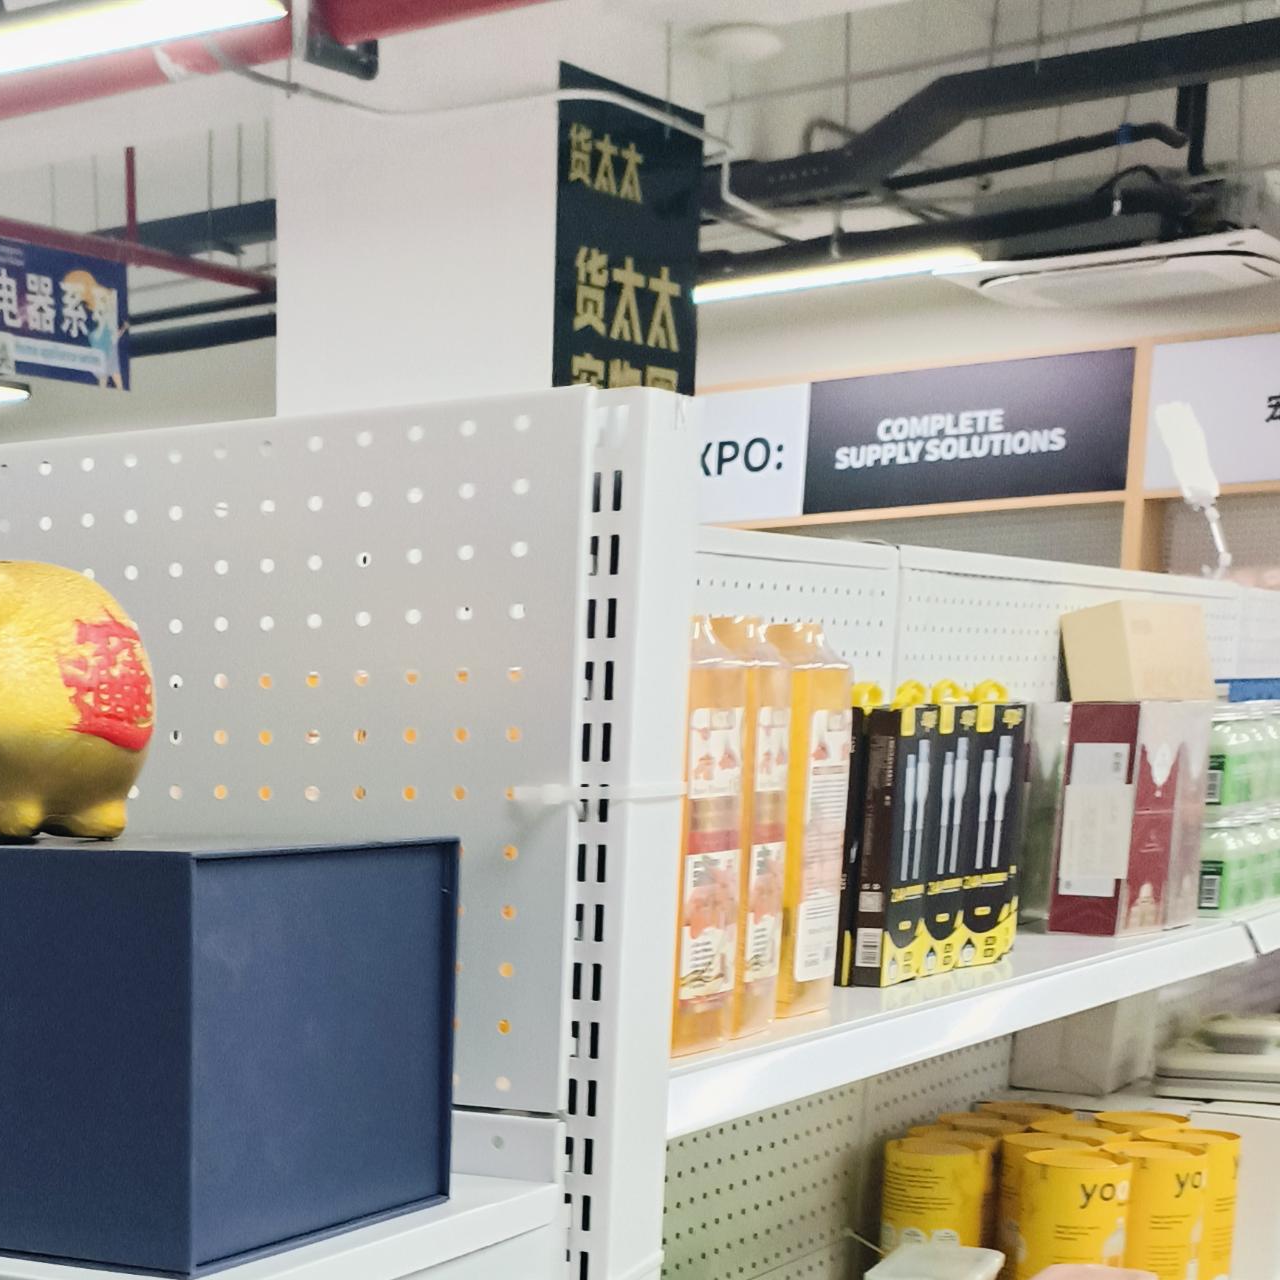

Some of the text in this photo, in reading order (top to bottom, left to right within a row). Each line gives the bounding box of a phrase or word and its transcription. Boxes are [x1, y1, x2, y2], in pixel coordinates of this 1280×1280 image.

[568, 122, 644, 204] 货太太
[573, 246, 682, 353] 货太太
[834, 427, 1067, 471] SUPPLY SOLUTIONS
[876, 408, 1006, 443] COMPLETE
